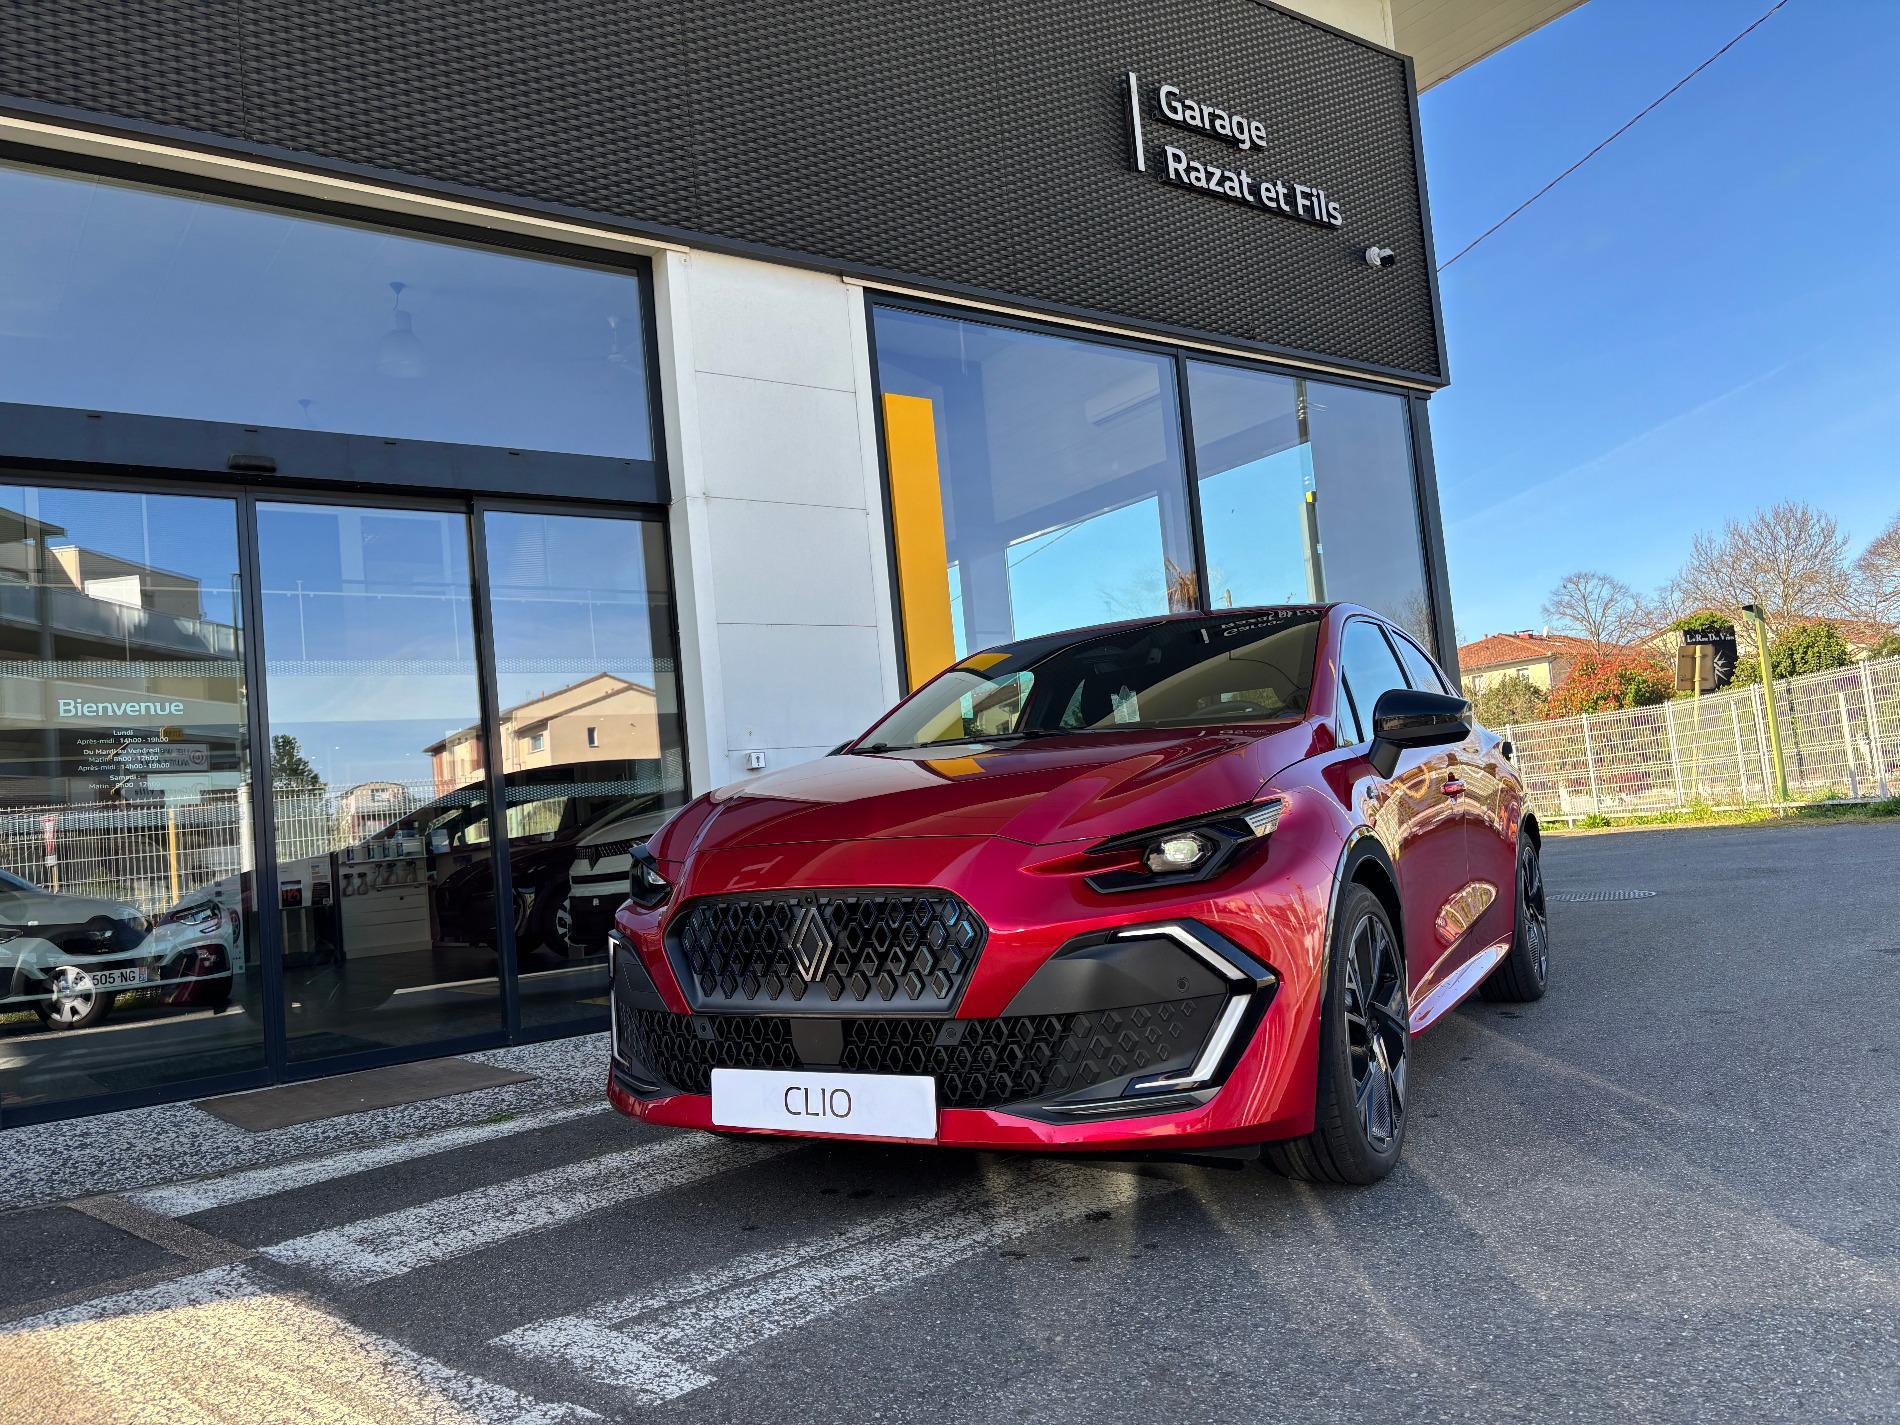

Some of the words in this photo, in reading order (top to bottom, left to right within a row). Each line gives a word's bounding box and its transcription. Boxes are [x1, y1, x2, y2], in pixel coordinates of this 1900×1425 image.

[1159, 84, 1267, 149] Garage
[1165, 145, 1254, 202] Razat
[1260, 180, 1290, 212] et
[1293, 183, 1343, 226] Fils
[58, 699, 184, 717] Bienvenue
[784, 1086, 852, 1119] CLIO
